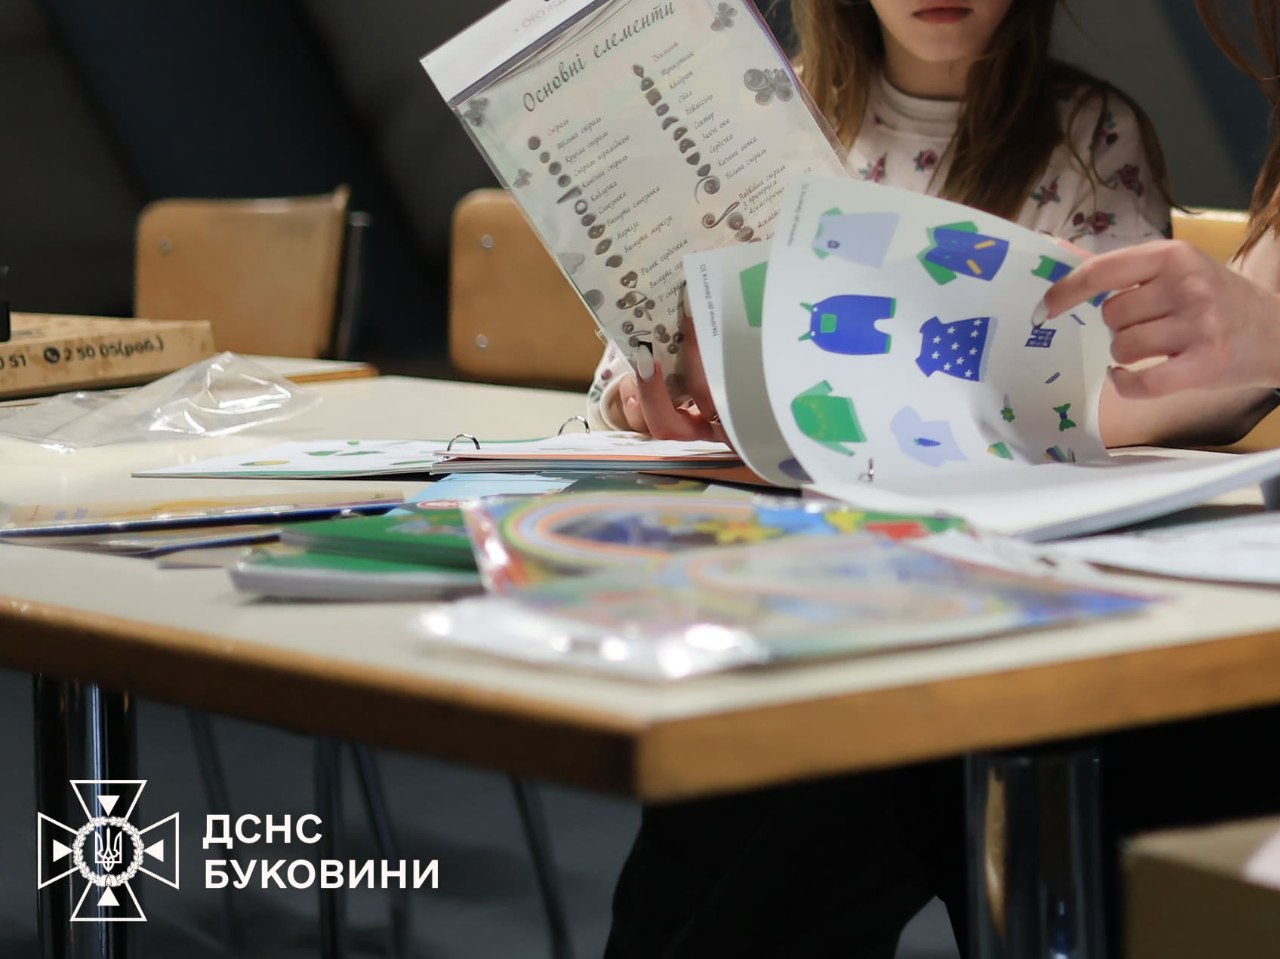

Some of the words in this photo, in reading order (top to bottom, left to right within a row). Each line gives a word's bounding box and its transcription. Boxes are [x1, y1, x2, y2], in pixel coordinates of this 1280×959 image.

[523, 53, 584, 112] Основні
[594, 2, 674, 58] елементи
[64, 348, 73, 361] 2
